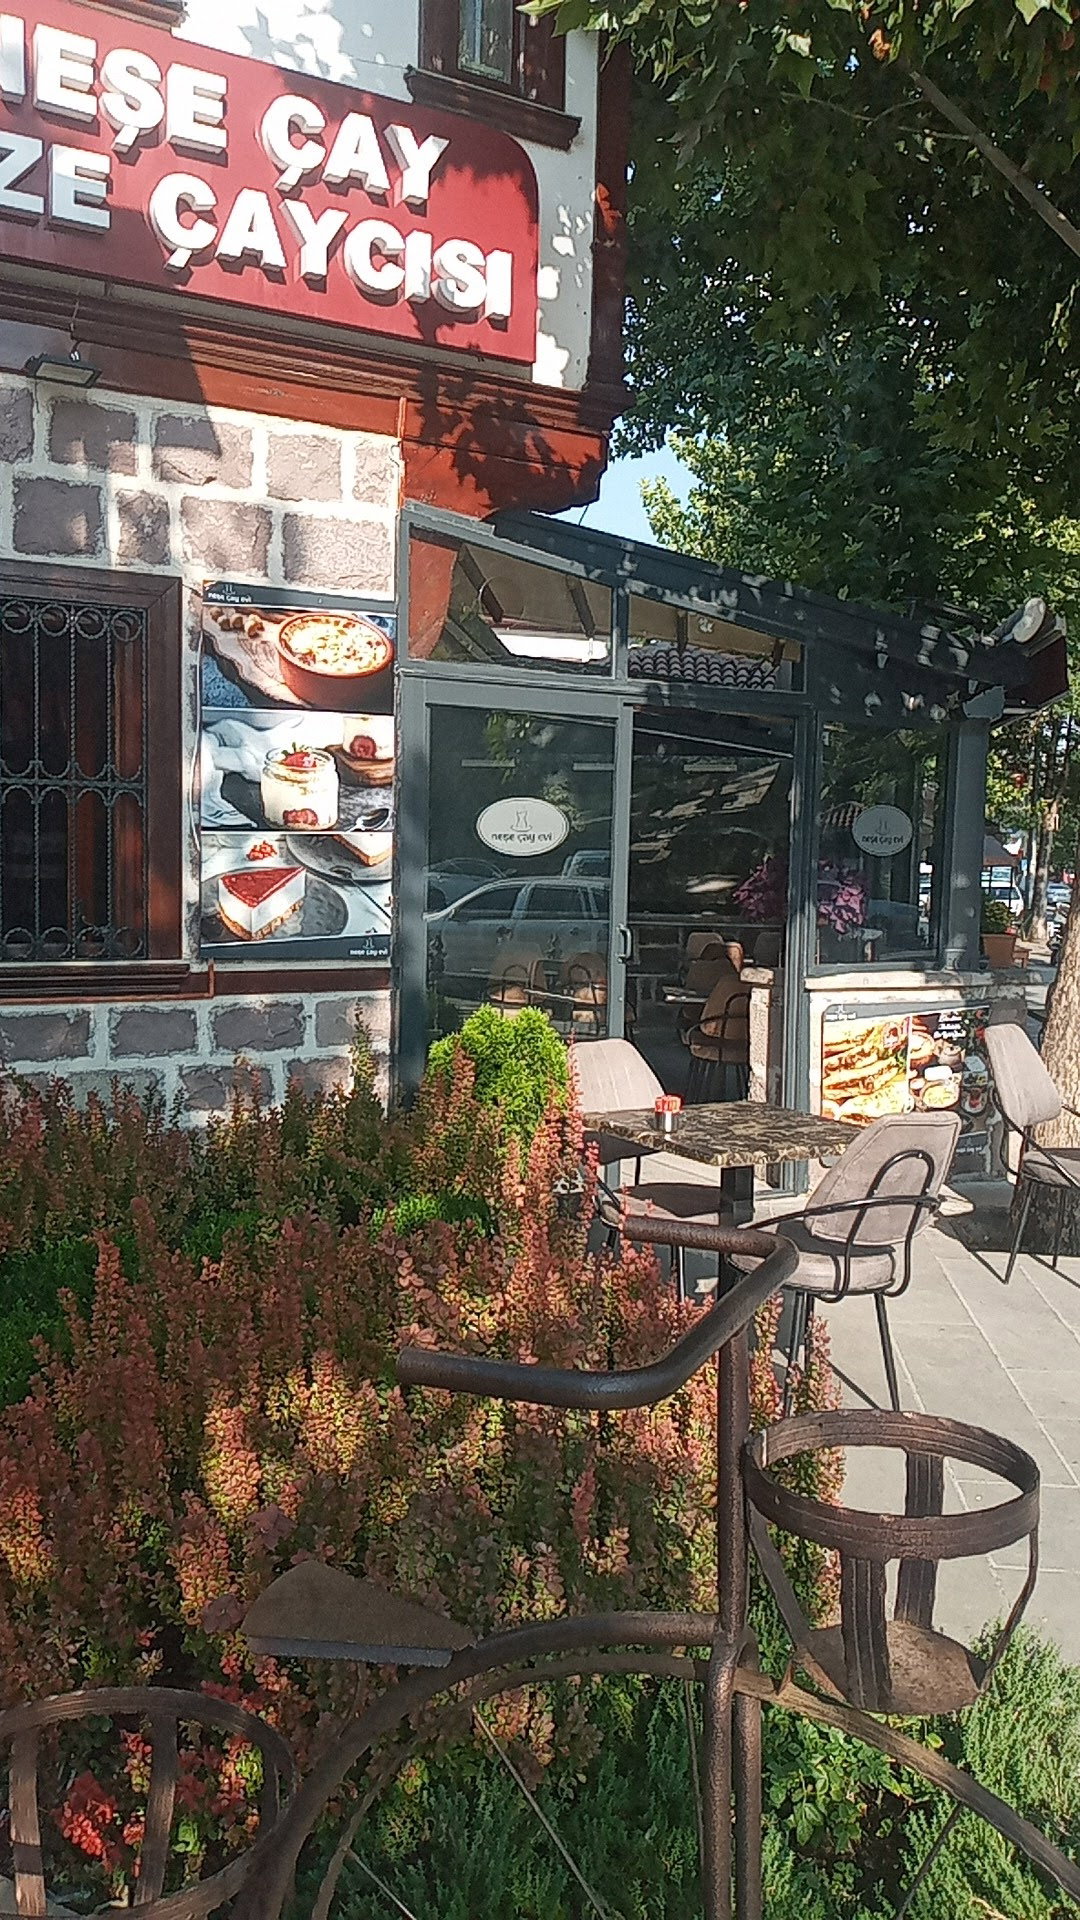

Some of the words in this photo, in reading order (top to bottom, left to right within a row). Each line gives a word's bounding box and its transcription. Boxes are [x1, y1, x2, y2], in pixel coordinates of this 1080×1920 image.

[260, 94, 449, 206] ÇAY
[149, 172, 513, 320] ÇAYCISI
[491, 833, 515, 843] neşe
[517, 833, 536, 844] çay
